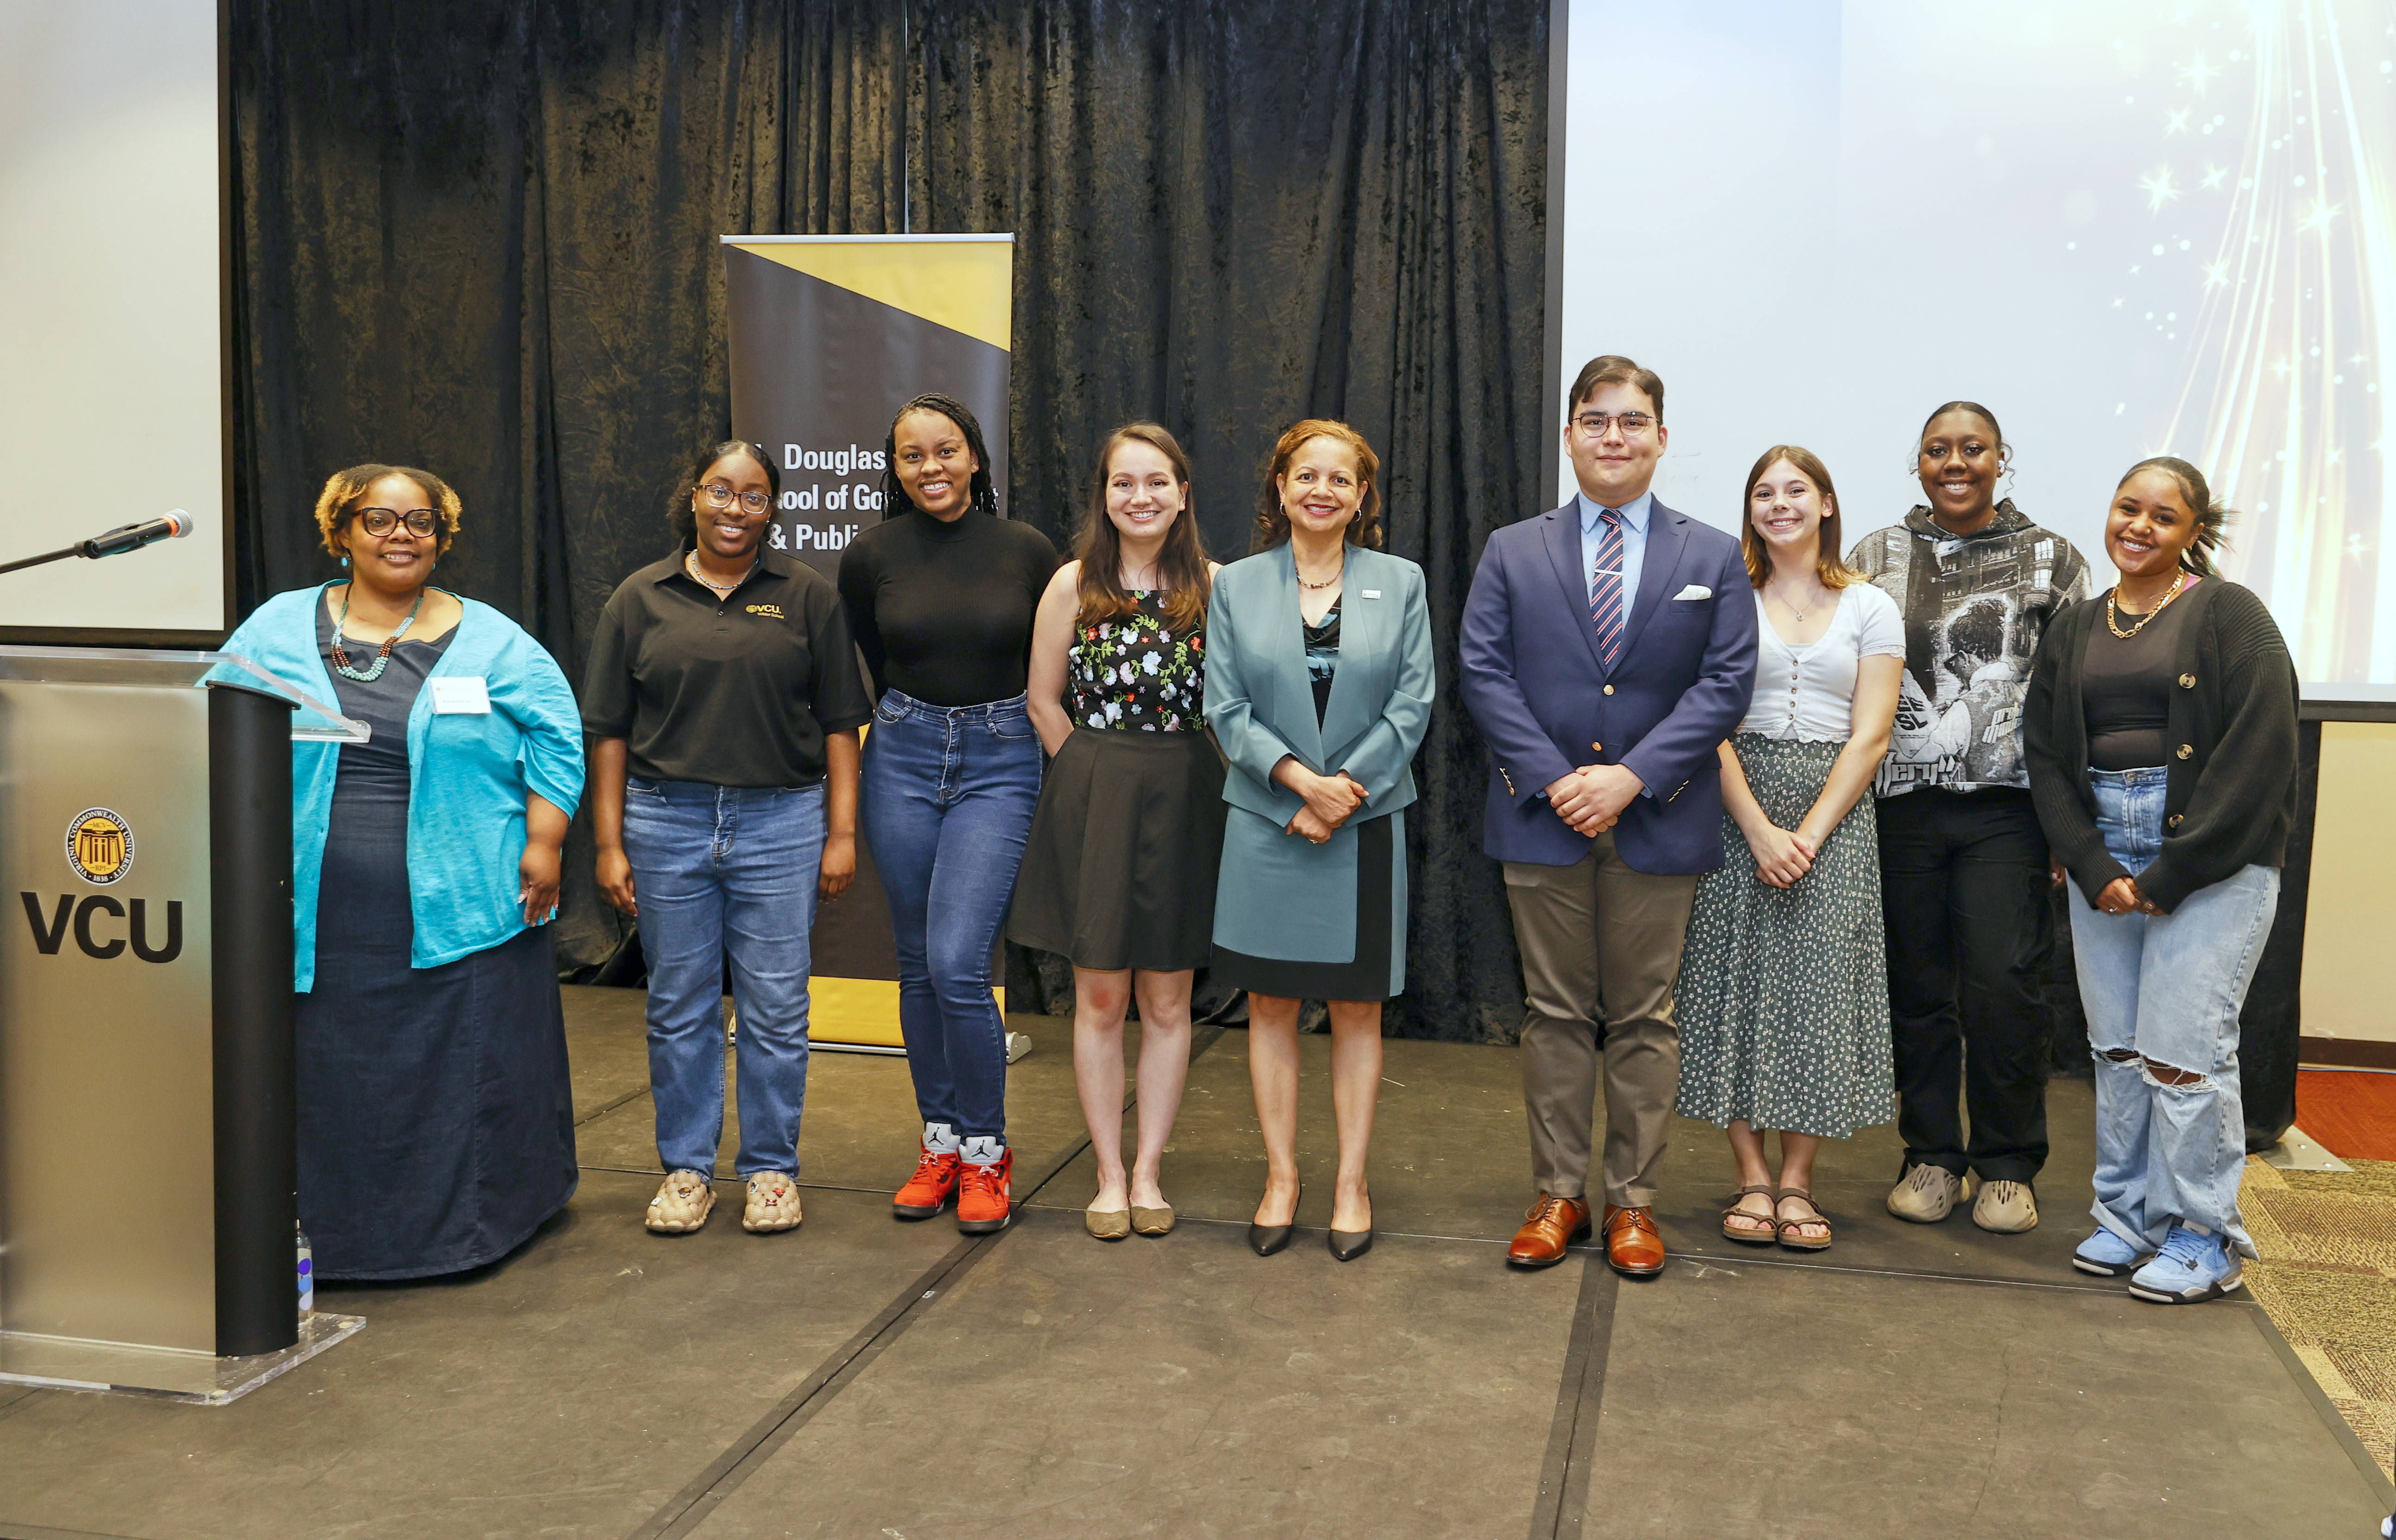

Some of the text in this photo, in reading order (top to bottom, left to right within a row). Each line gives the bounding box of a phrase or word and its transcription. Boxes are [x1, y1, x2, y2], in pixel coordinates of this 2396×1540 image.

[784, 443, 887, 476] Douglas
[825, 484, 849, 510] of
[767, 524, 788, 550] &
[68, 810, 132, 879] VIRGINIA COMMONWEALTH UNIVERSITY
[20, 891, 183, 963] VCU
